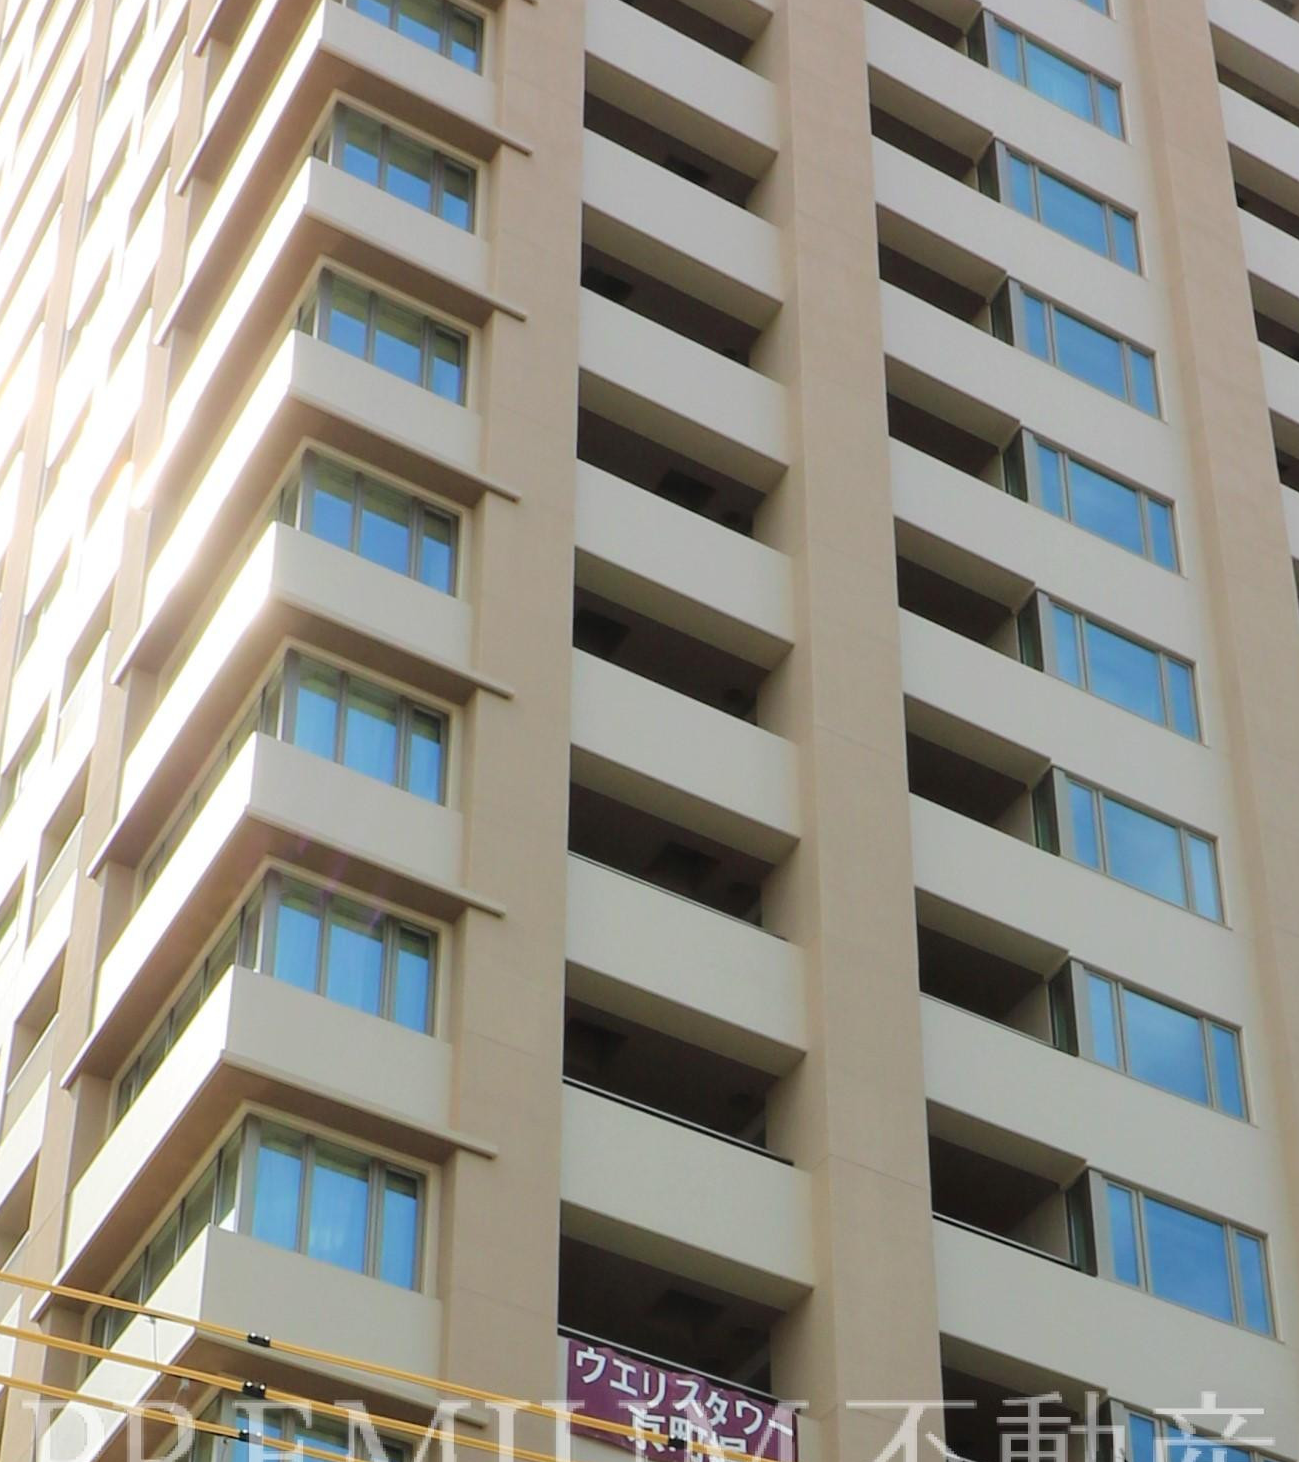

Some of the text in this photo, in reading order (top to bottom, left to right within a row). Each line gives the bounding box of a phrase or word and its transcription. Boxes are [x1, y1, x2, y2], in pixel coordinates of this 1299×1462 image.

[575, 1346, 794, 1437] ウエリスタワー
